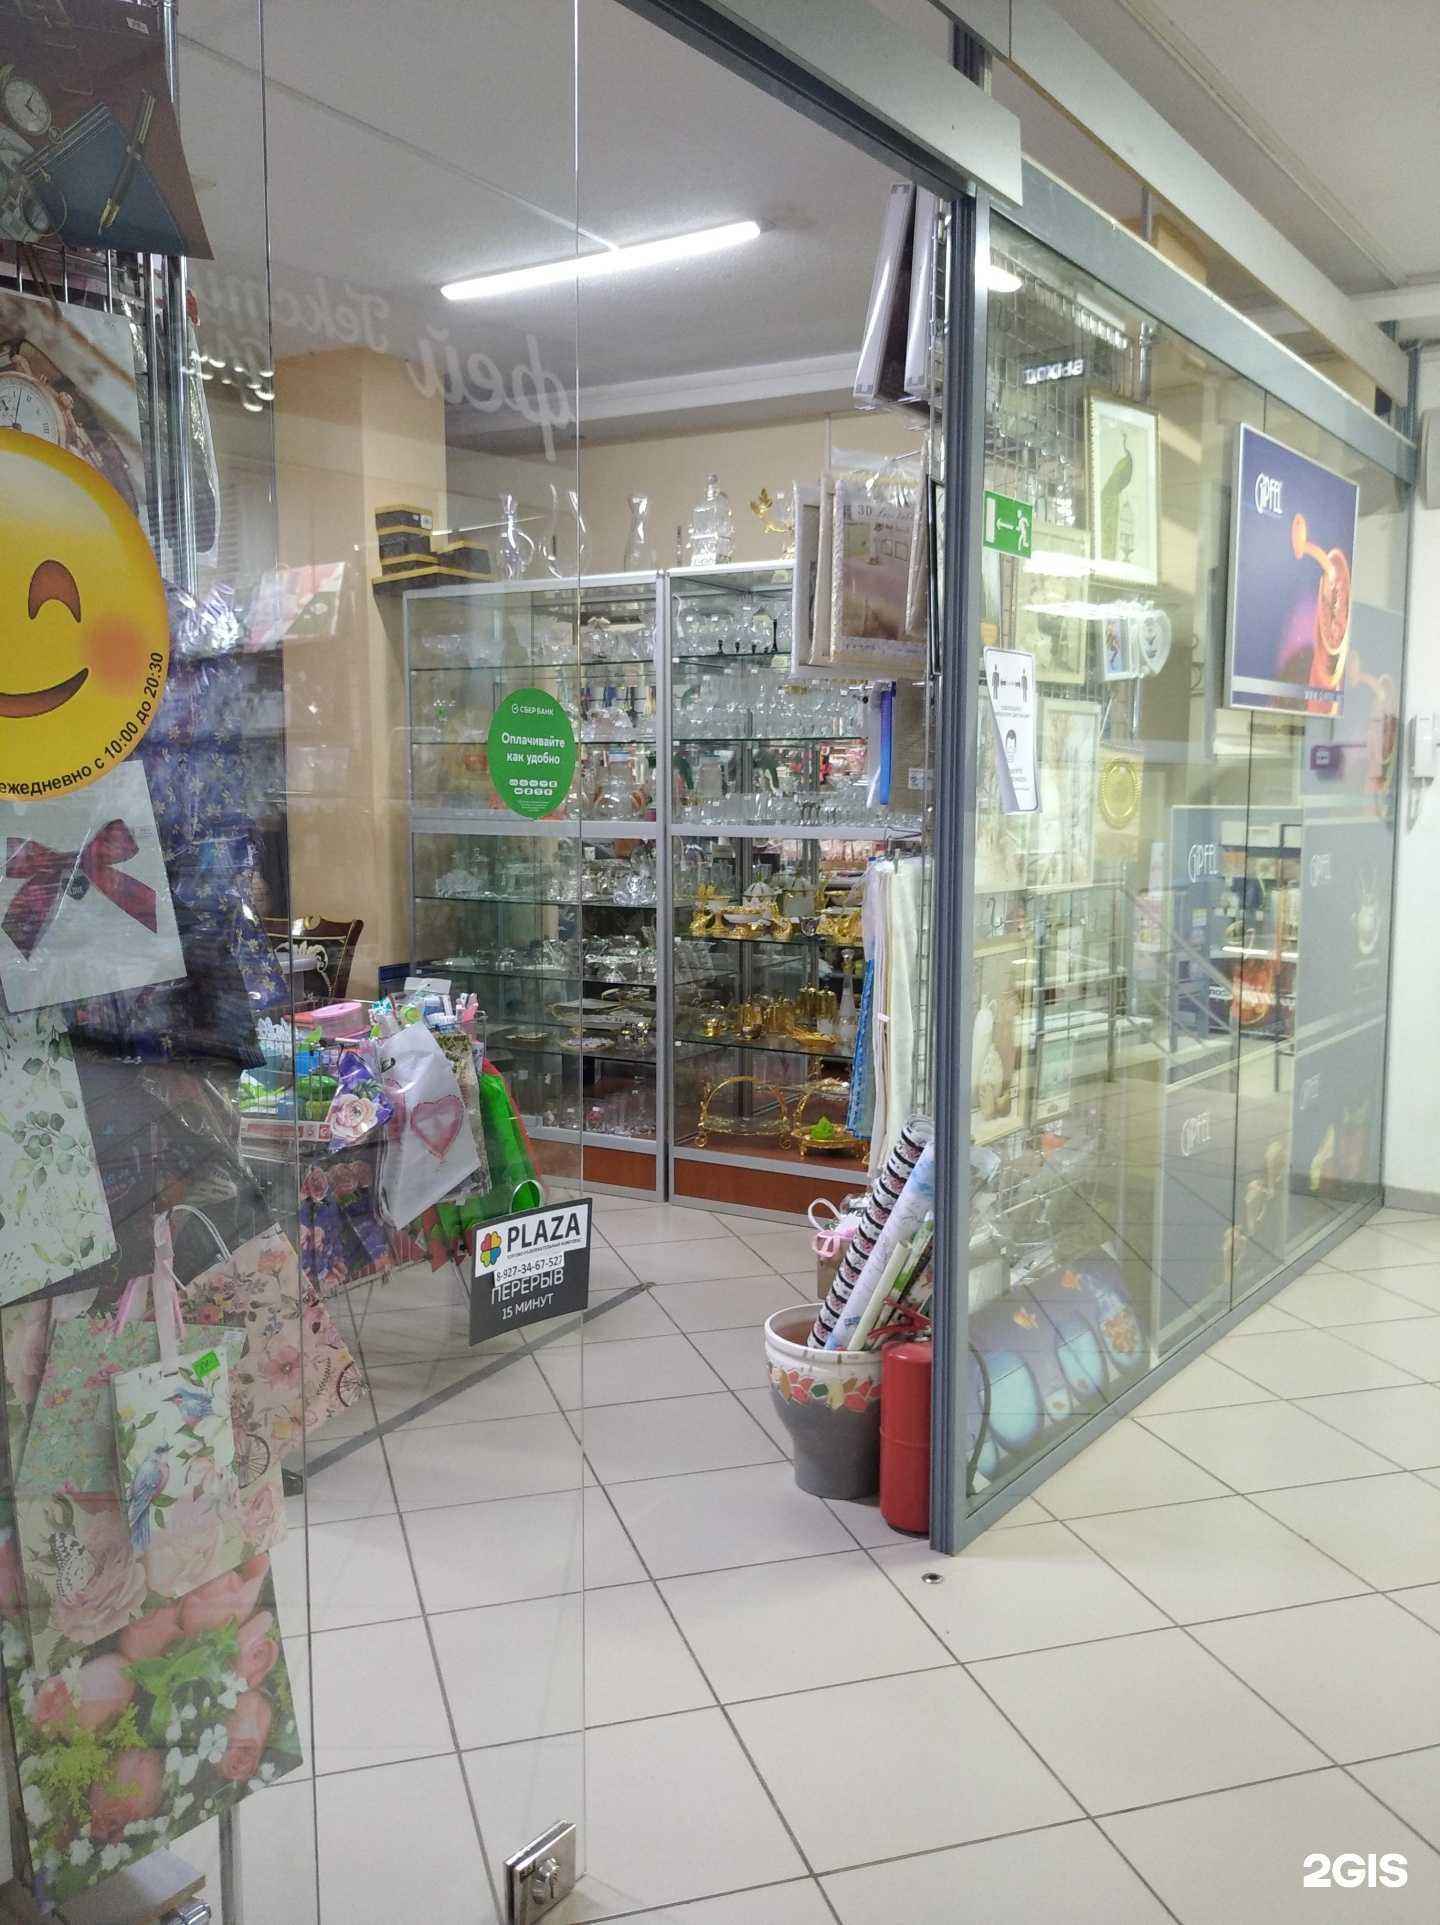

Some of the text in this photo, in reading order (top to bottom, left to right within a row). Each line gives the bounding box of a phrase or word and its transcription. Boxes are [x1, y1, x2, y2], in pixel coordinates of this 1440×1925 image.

[0, 652, 163, 796] ежедневно с 10:00 до 20:30
[502, 732, 565, 748] Оплачивайте
[507, 752, 560, 765] как удобно
[506, 1212, 581, 1253] PLAZA
[495, 1254, 563, 1282] 8-927-34-67-527
[490, 1267, 565, 1305] ПЕРЕРЫВ
[501, 1292, 555, 1321] 15 МИНУТ
